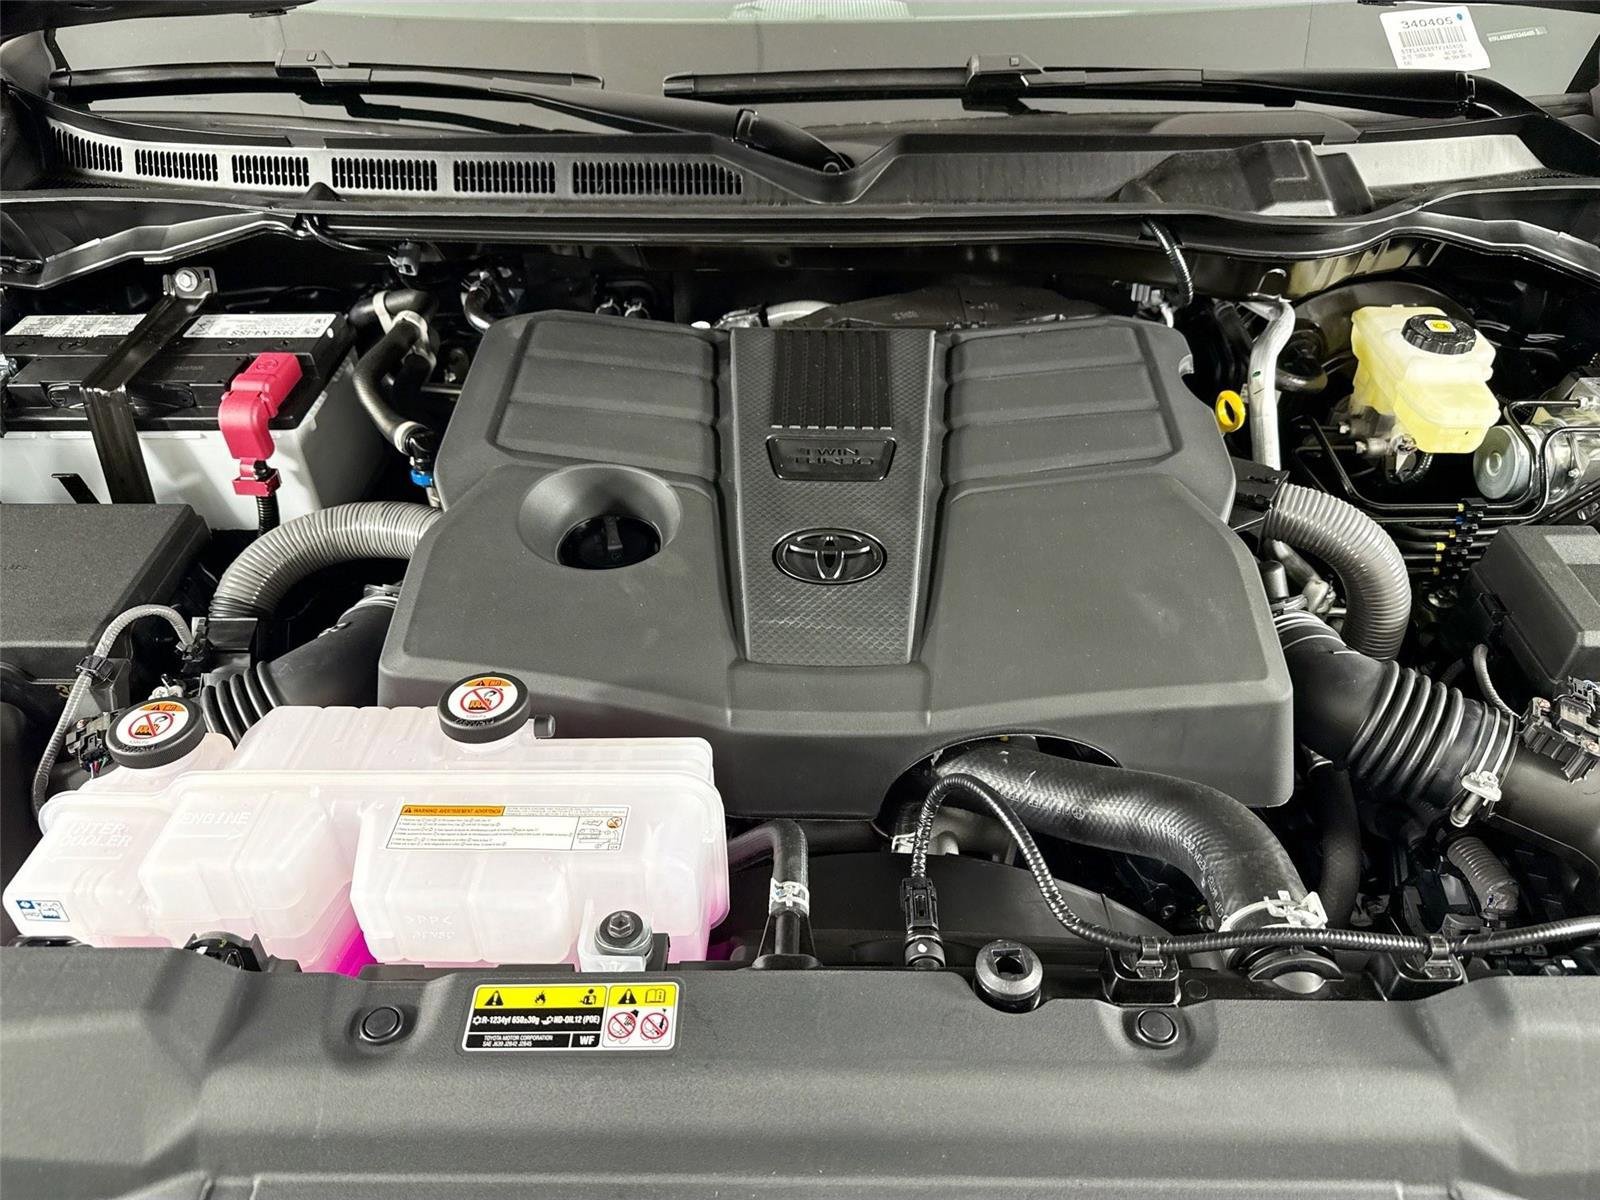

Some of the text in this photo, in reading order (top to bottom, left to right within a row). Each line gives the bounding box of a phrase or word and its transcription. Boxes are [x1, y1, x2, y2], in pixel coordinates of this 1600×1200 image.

[798, 447, 860, 456] TWIN
[180, 811, 251, 824] ENGINE
[60, 834, 133, 847] COOLER
[481, 1015, 511, 1025] R-1234yf
[583, 1015, 600, 1025] (POE)
[579, 1035, 596, 1046] WF
